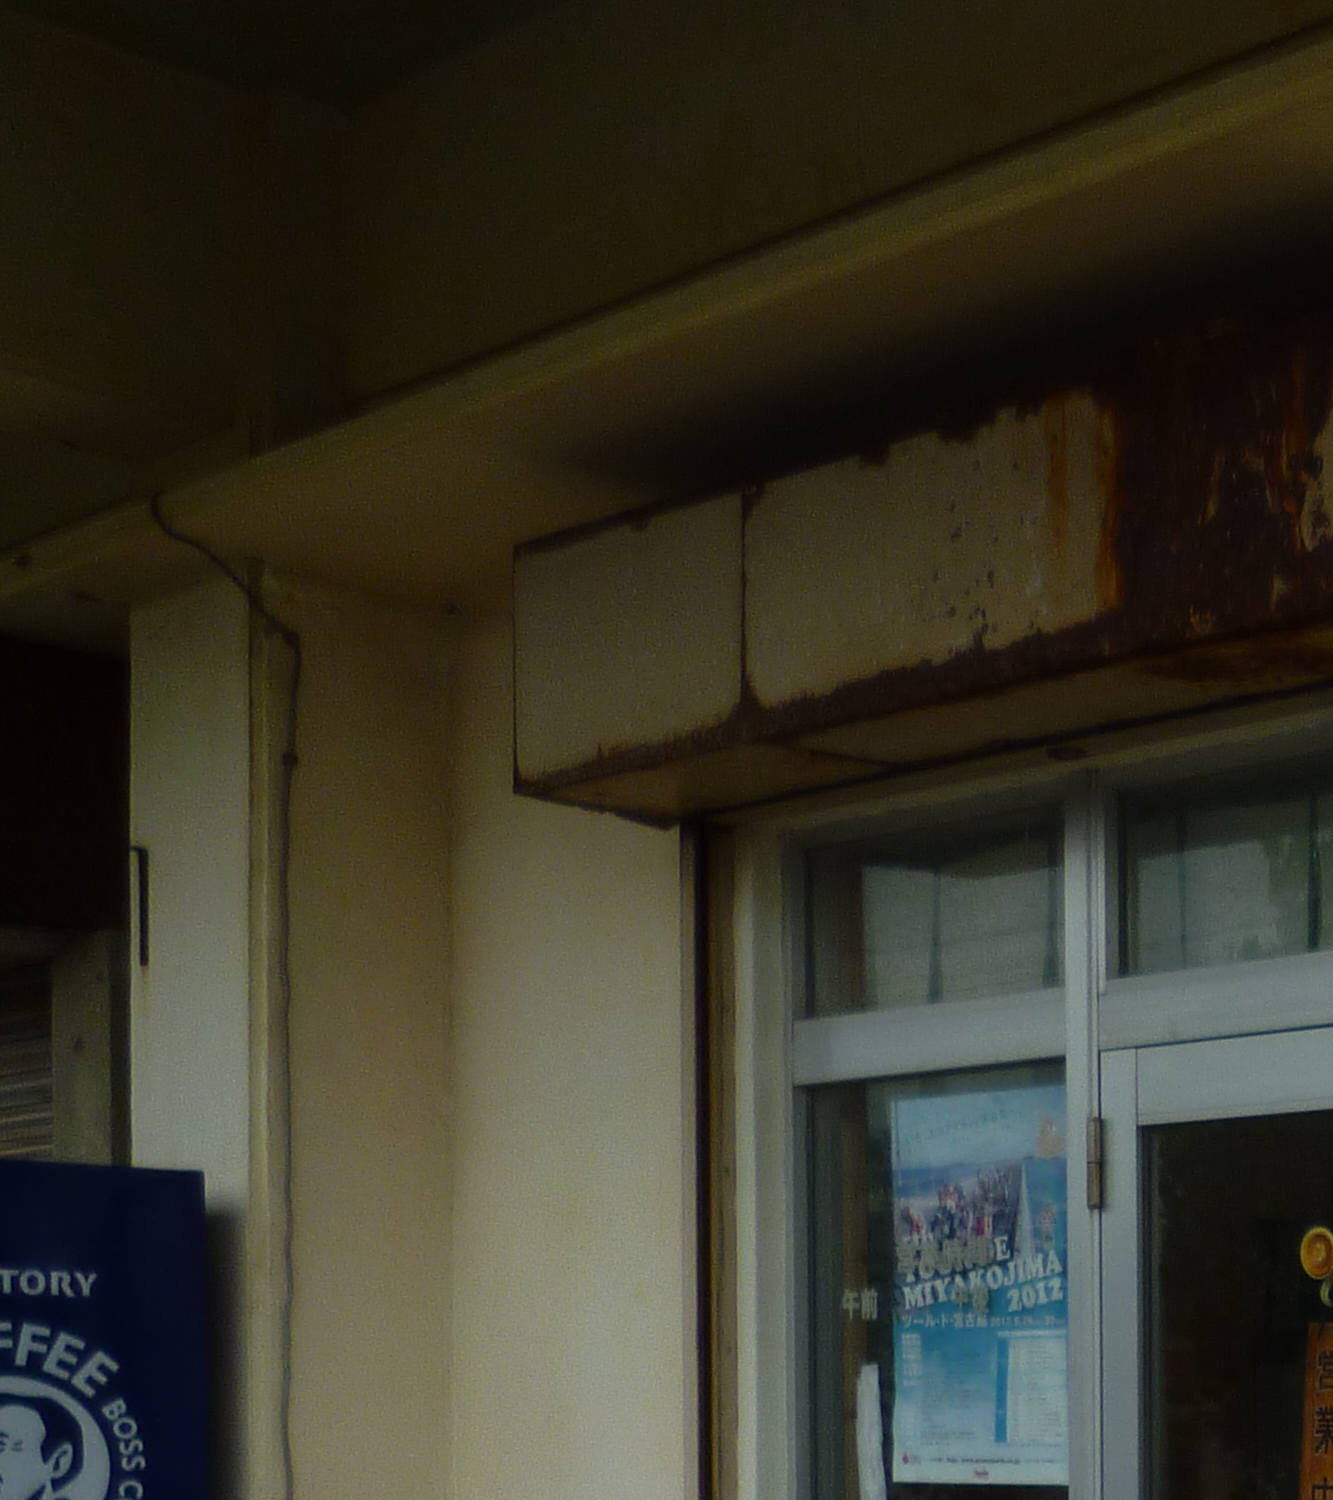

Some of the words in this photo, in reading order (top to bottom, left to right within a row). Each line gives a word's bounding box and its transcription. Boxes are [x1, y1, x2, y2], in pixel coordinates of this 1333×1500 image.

[902, 1249, 1063, 1311] MIYAKOJIMA
[1007, 1277, 1064, 1313] 2012
[102, 1397, 147, 1472] BOSS
